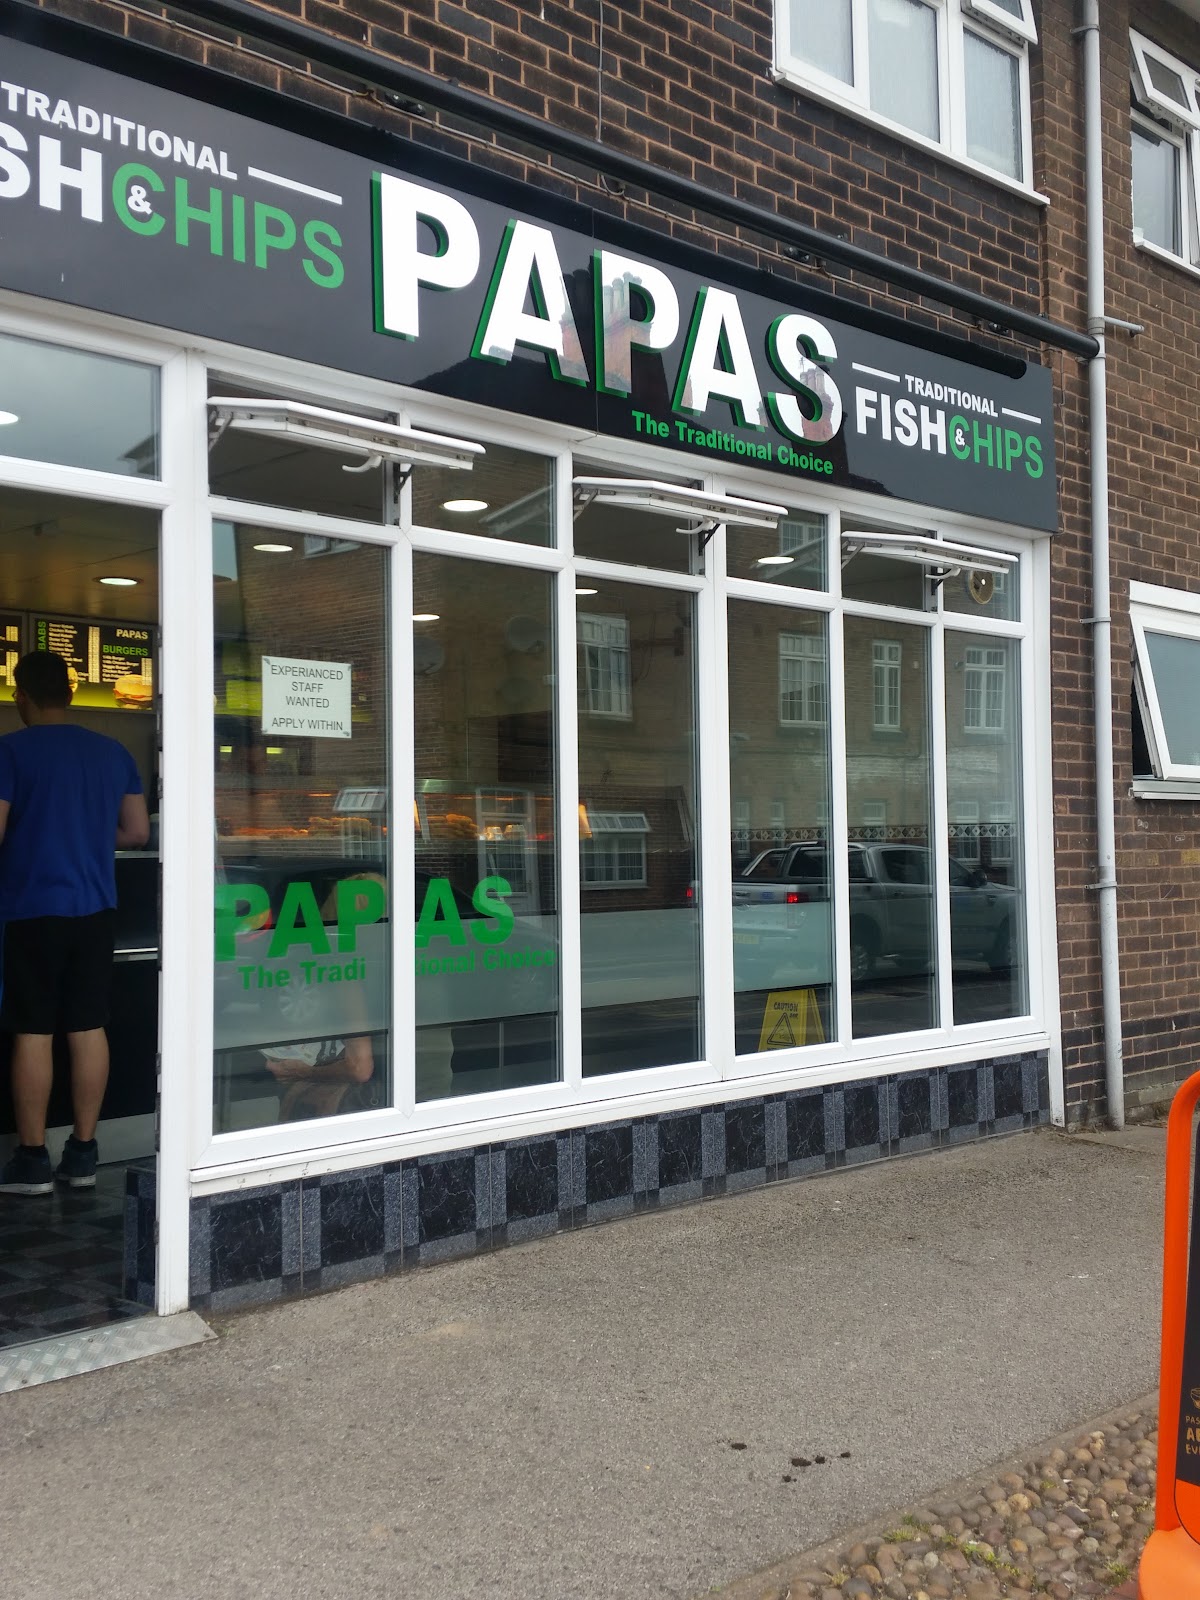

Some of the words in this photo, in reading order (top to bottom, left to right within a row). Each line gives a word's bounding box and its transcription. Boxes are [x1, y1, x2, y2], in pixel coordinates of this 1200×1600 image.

[0, 81, 238, 180] TRADITIONAL
[0, 121, 104, 222] SH
[127, 184, 152, 214] &
[112, 162, 345, 289] CHIPS
[371, 170, 844, 446] PAPAS
[904, 373, 999, 418] TRADITIONAL
[631, 410, 670, 438] The
[677, 417, 772, 461] Traditional
[777, 444, 834, 475] Choice
[855, 386, 947, 455] FISH
[948, 414, 1044, 479] CHIPS
[38, 621, 46, 651] BABS
[116, 628, 149, 640] PAPAS
[102, 644, 149, 656] BURGERS
[271, 664, 344, 680] EXPERIANCED
[291, 681, 323, 693] STAFF
[286, 695, 330, 708] WANTED
[271, 717, 305, 729] APPLY
[307, 719, 343, 731] WITHIN
[238, 965, 290, 990] The
[483, 944, 556, 972] Choice
[773, 1001, 799, 1013] CAUTION
